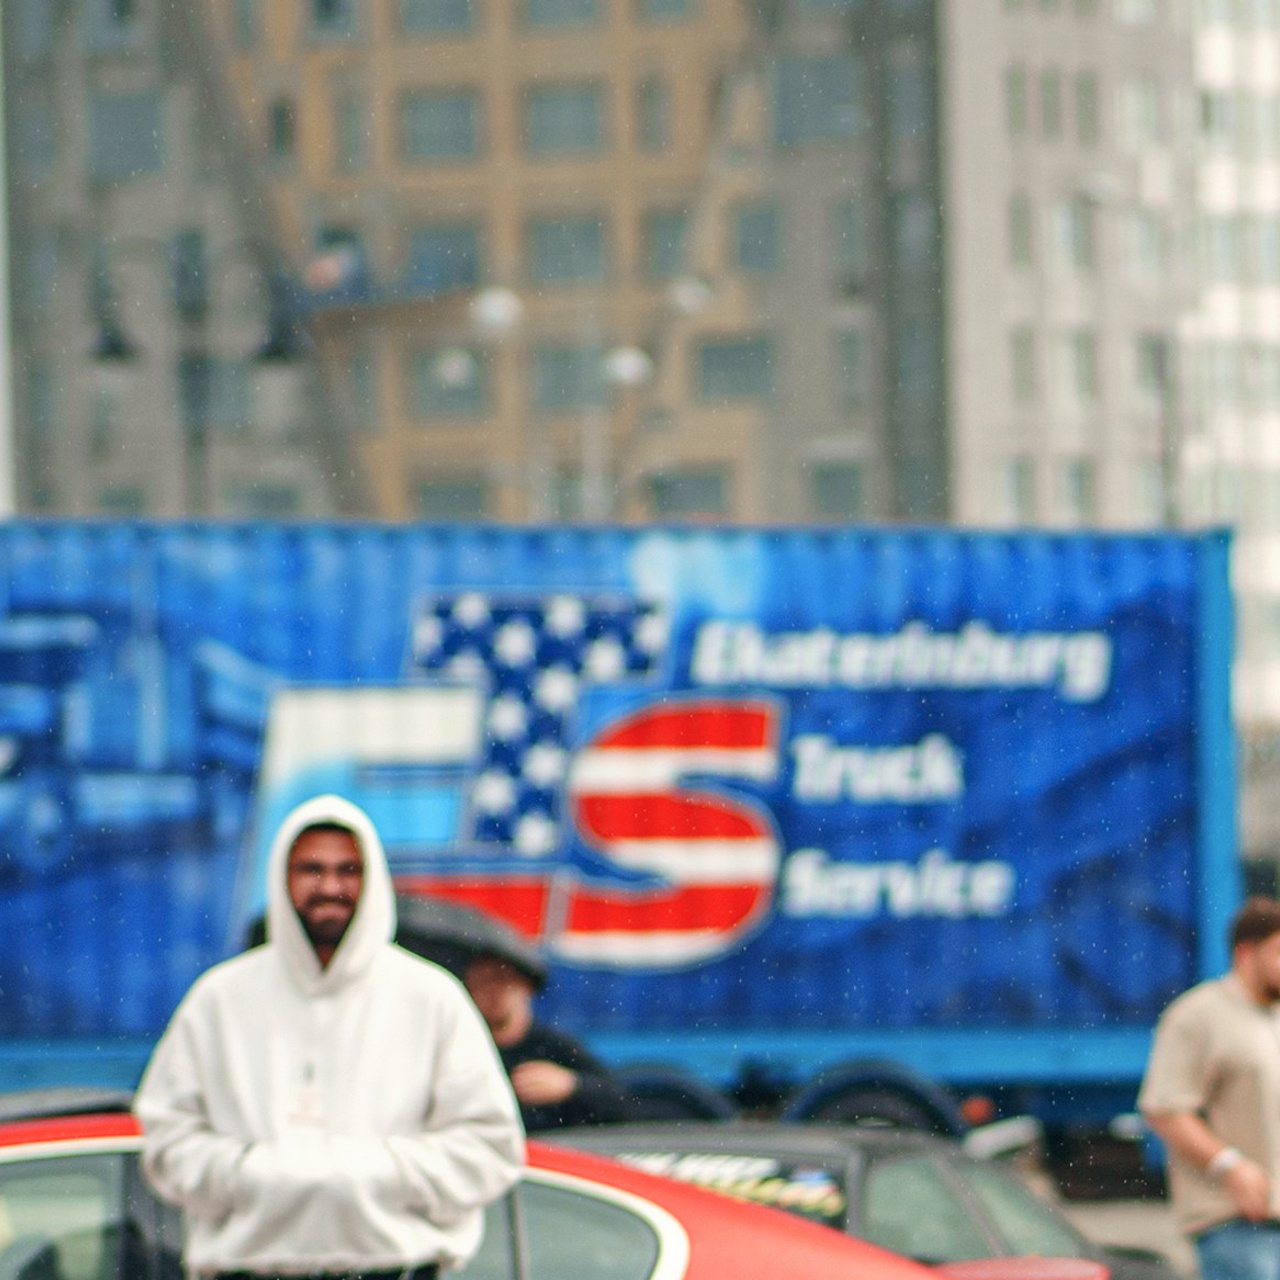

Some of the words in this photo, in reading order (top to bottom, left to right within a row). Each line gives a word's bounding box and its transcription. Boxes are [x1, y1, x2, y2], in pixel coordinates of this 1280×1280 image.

[693, 620, 1110, 703] Ekaterinburg
[792, 733, 963, 803] Truck
[783, 849, 1017, 918] Service
